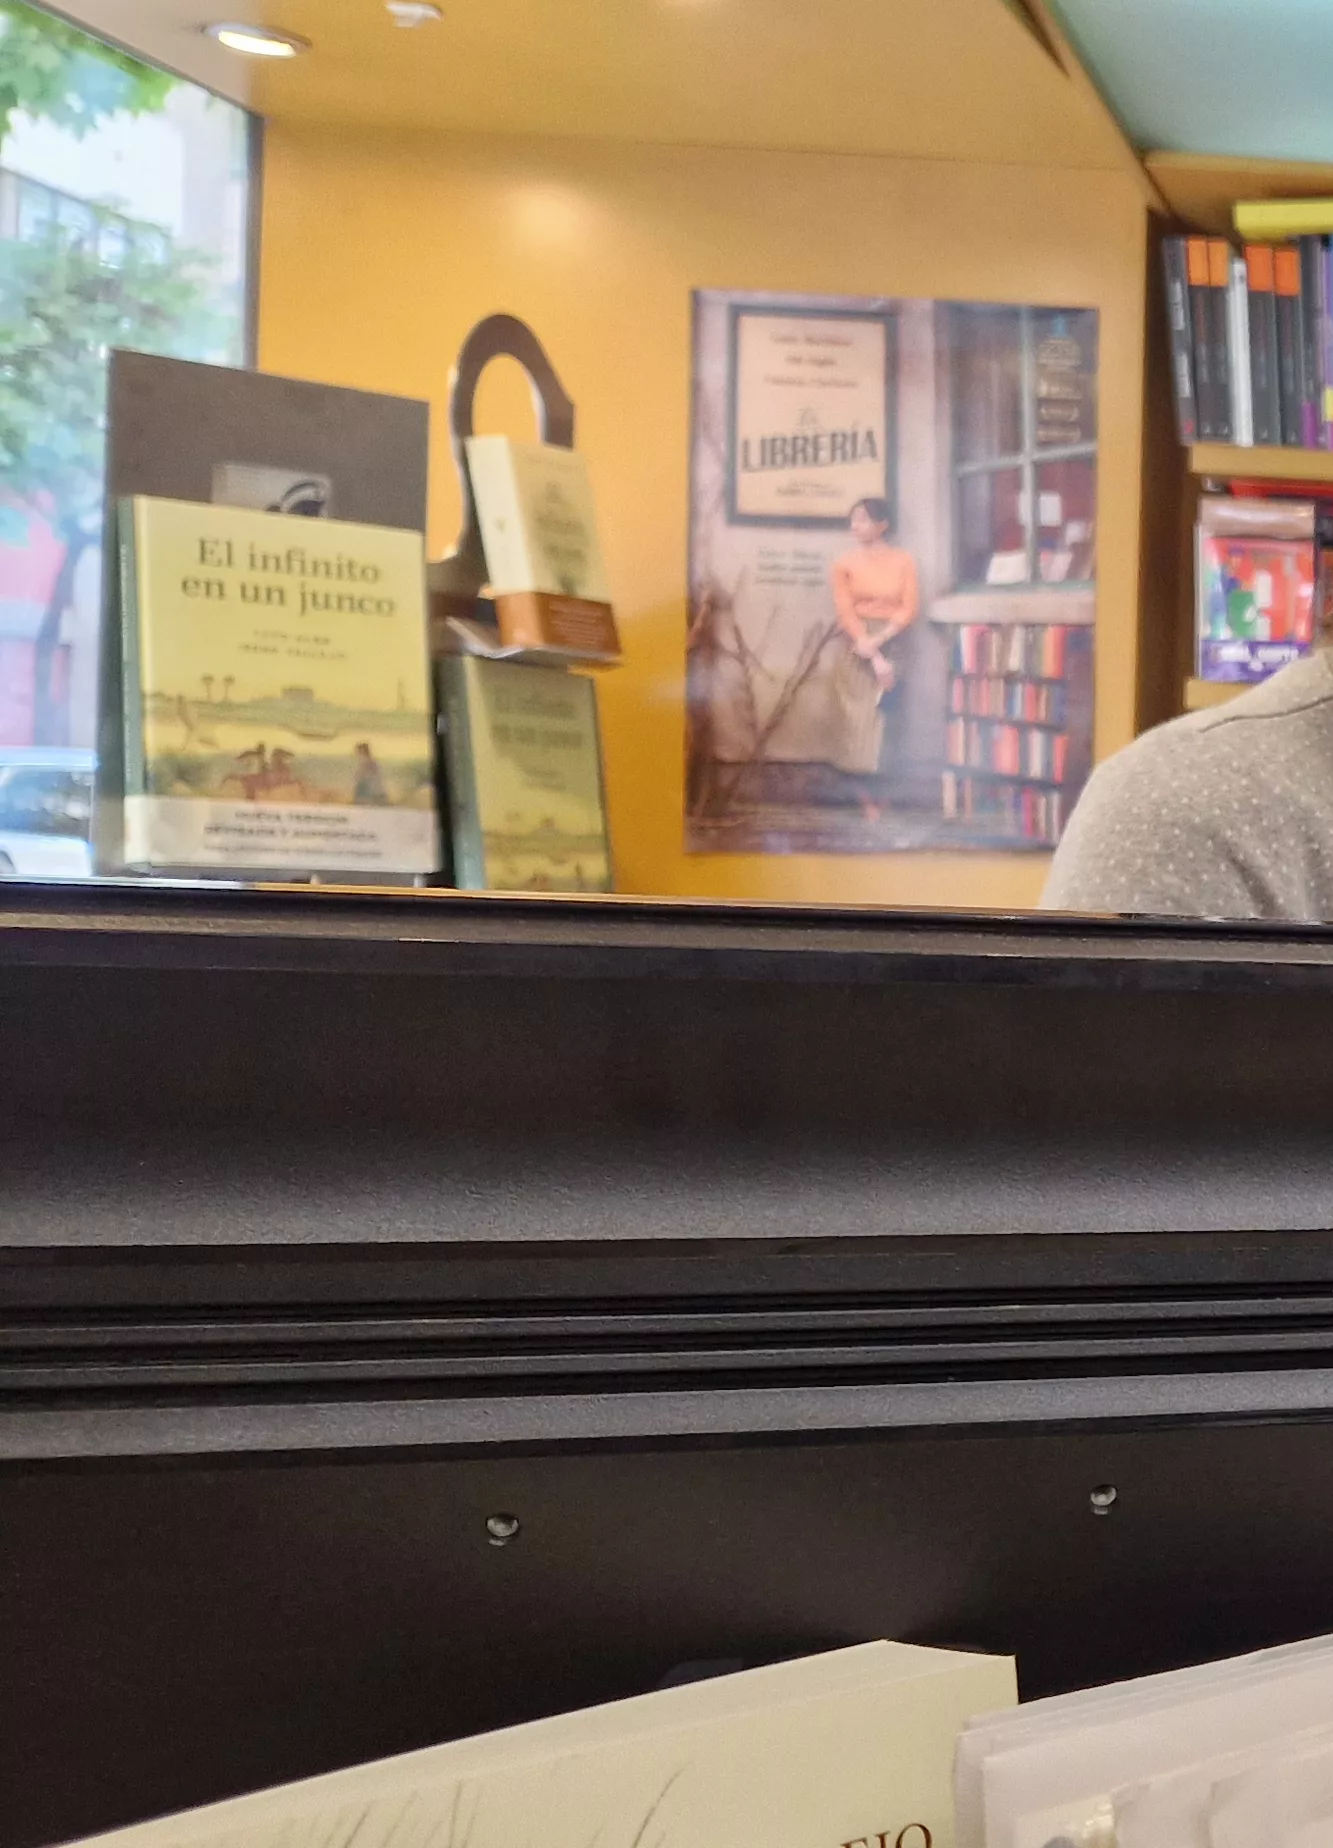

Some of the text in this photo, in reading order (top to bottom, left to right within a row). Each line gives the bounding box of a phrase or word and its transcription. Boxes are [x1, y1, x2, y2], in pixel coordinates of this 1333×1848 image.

[742, 420, 879, 474] LIBRERÍA
[199, 536, 381, 584] El infinito
[181, 575, 396, 617] en un junco
